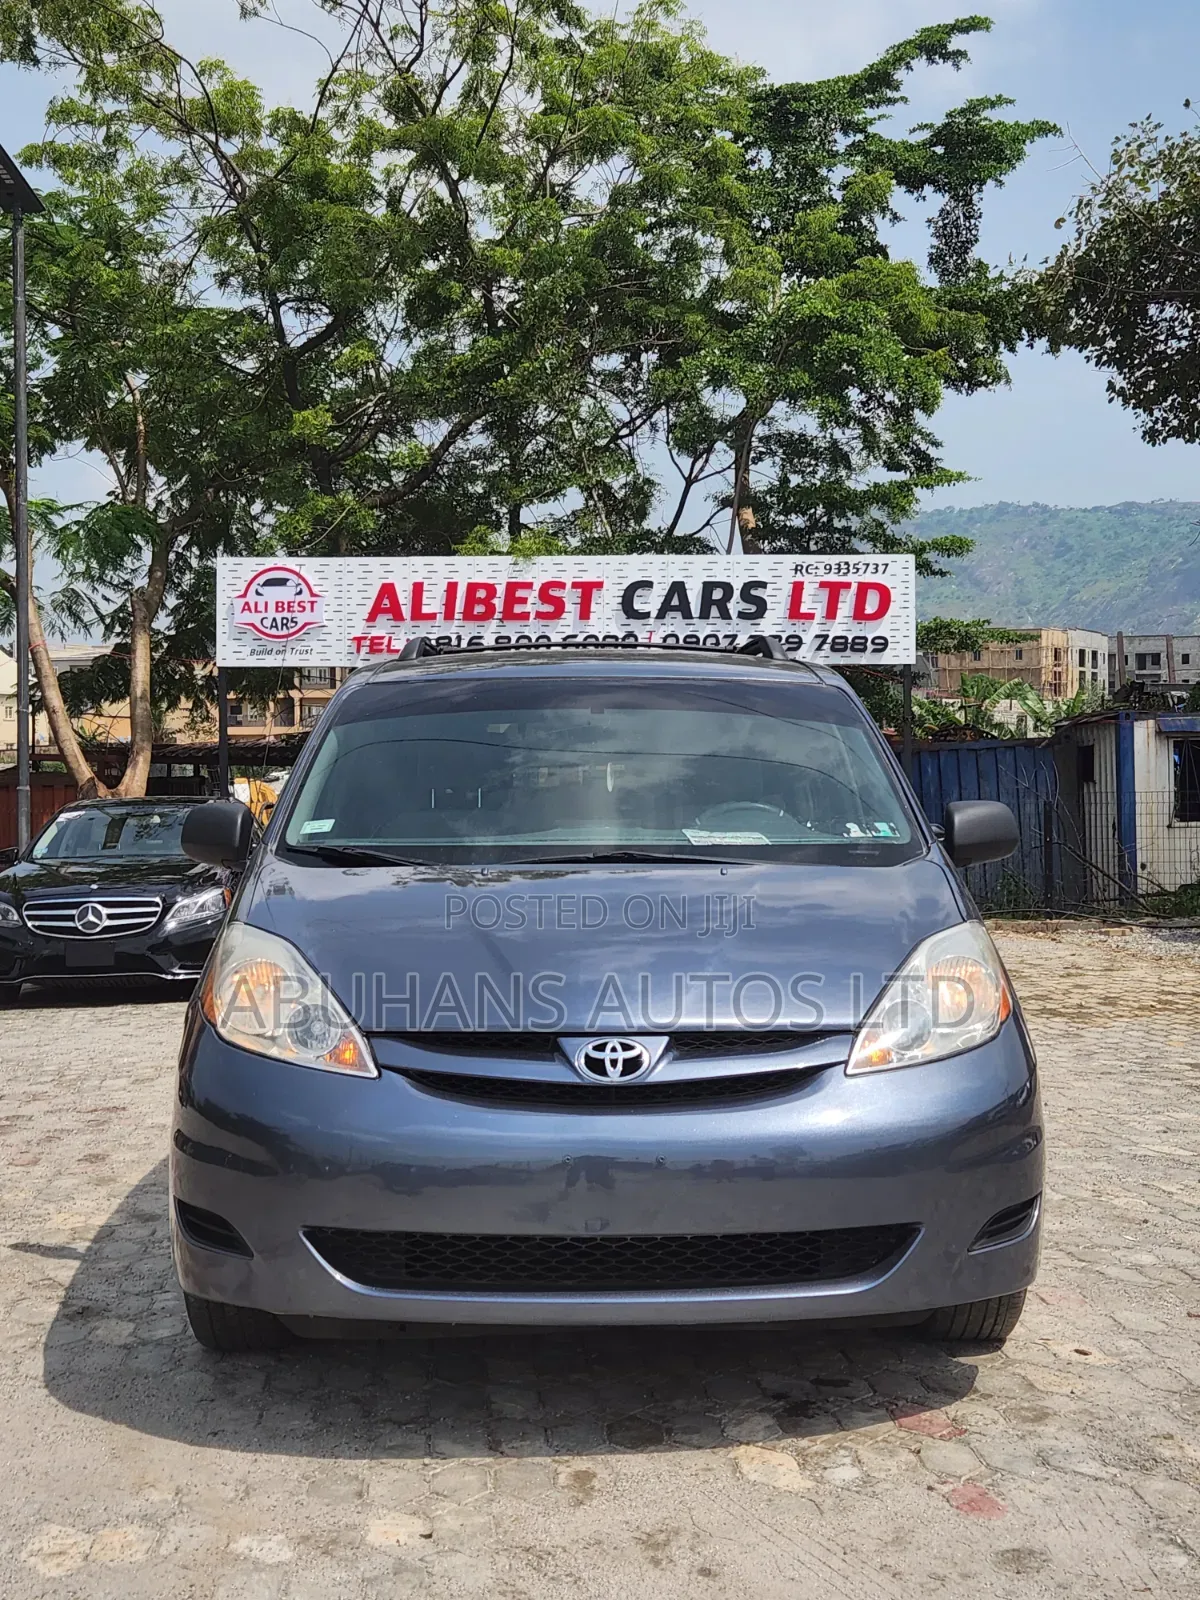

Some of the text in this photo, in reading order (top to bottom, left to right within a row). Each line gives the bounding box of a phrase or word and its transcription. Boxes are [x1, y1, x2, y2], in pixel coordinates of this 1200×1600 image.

[240, 600, 318, 614] ALI BEST
[366, 580, 892, 623] ALIBEST CARS LTD
[260, 616, 299, 631] CARS
[814, 633, 890, 653] 7889
[249, 647, 274, 656] Build
[290, 647, 314, 656] Trust
